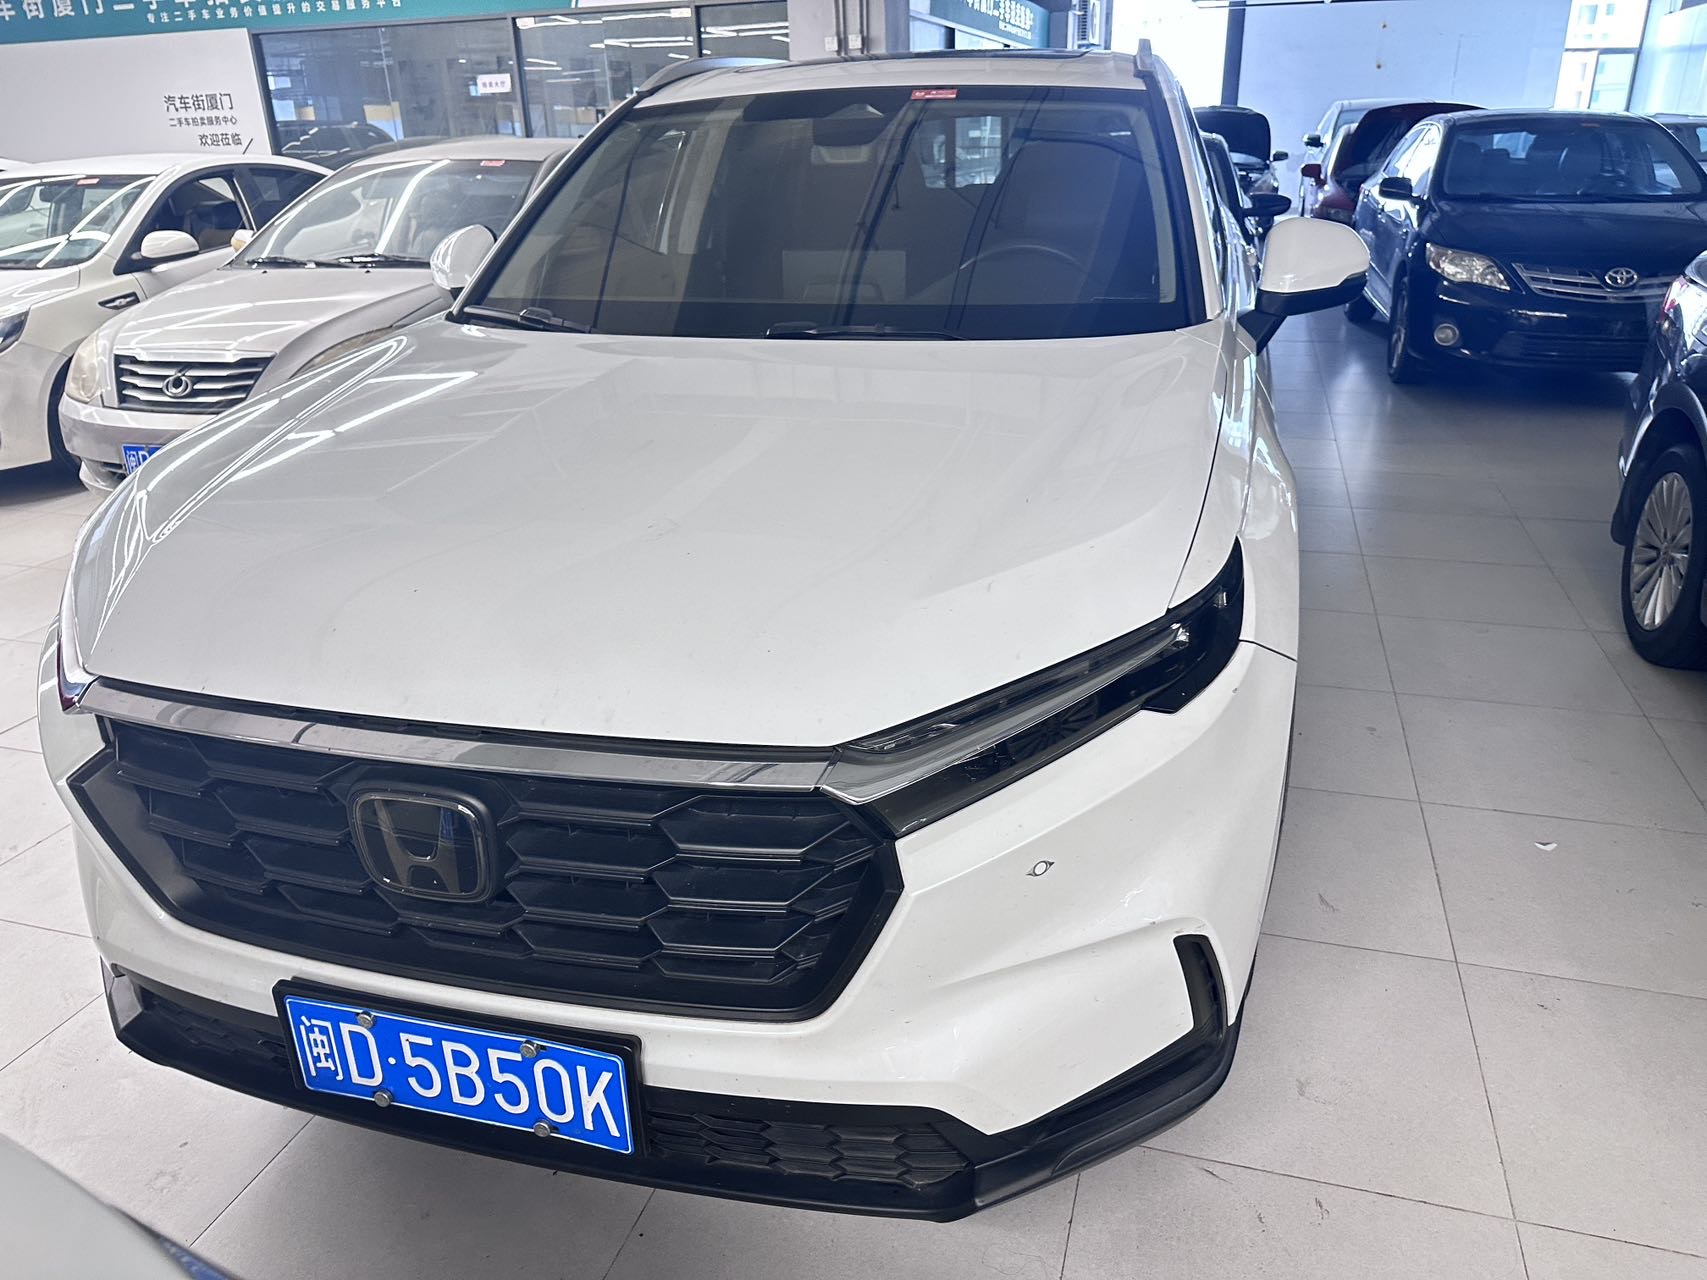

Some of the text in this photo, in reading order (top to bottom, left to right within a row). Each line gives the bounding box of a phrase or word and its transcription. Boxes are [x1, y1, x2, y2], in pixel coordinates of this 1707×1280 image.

[163, 92, 234, 112] 汽车街厦门
[168, 115, 238, 127] 二手车拍卖服务中心
[197, 132, 243, 147] 欢迎莅临
[299, 1014, 621, 1138] 闽D·5B50K
